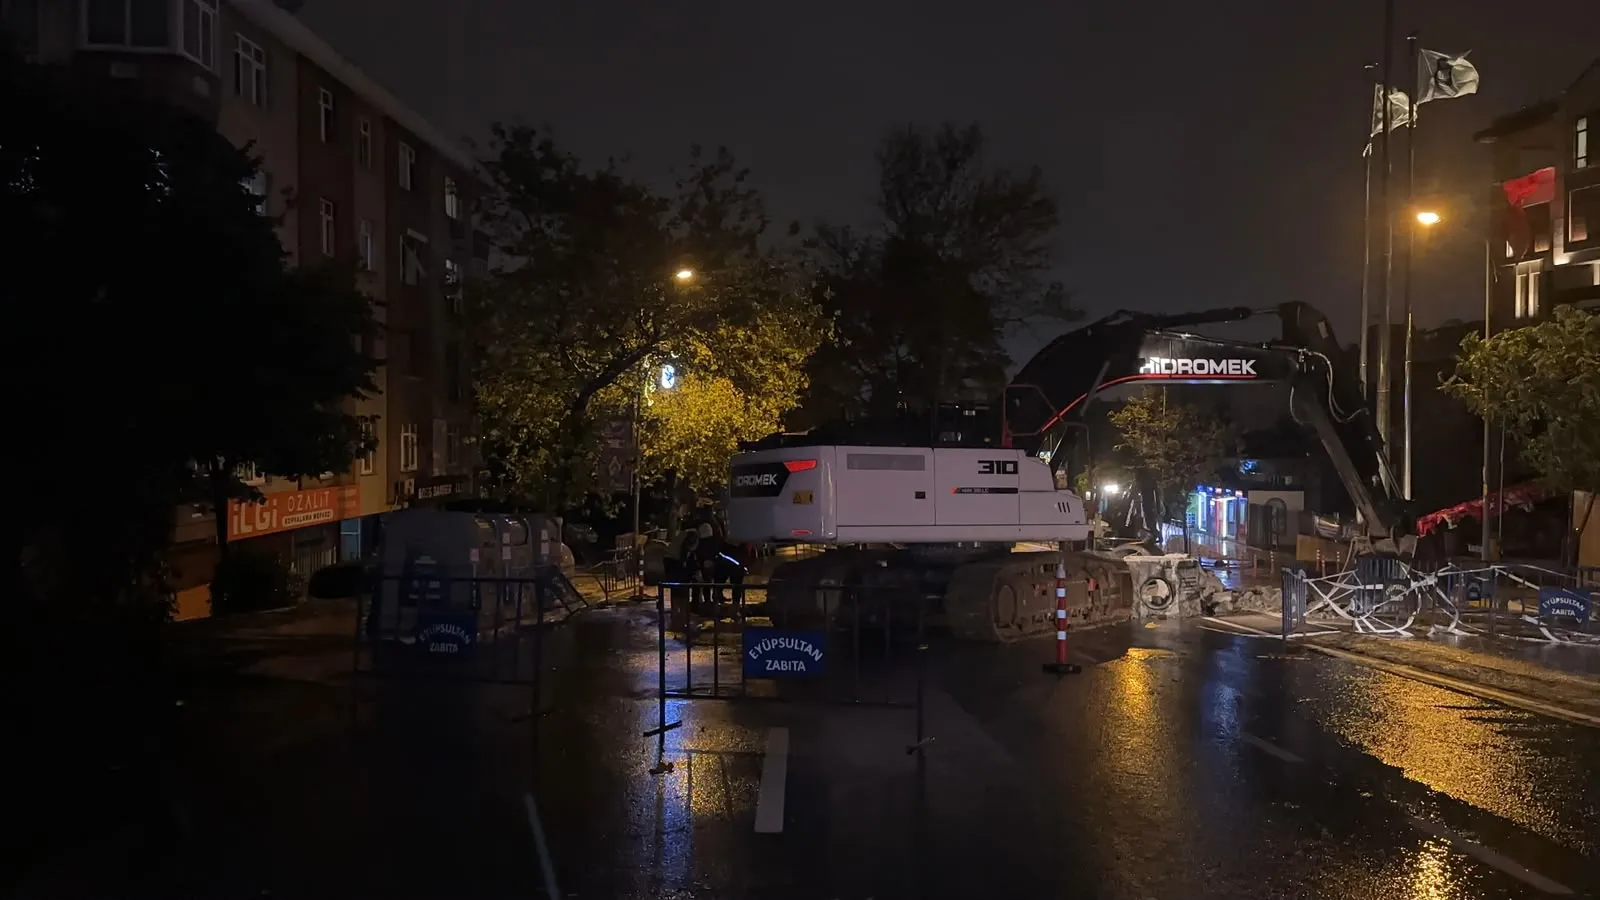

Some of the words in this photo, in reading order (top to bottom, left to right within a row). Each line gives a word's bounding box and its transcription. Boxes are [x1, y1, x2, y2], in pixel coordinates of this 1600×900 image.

[978, 460, 1018, 474] 310
[748, 637, 824, 662] EYÜPSULTAN
[765, 659, 807, 672] ZABITA
